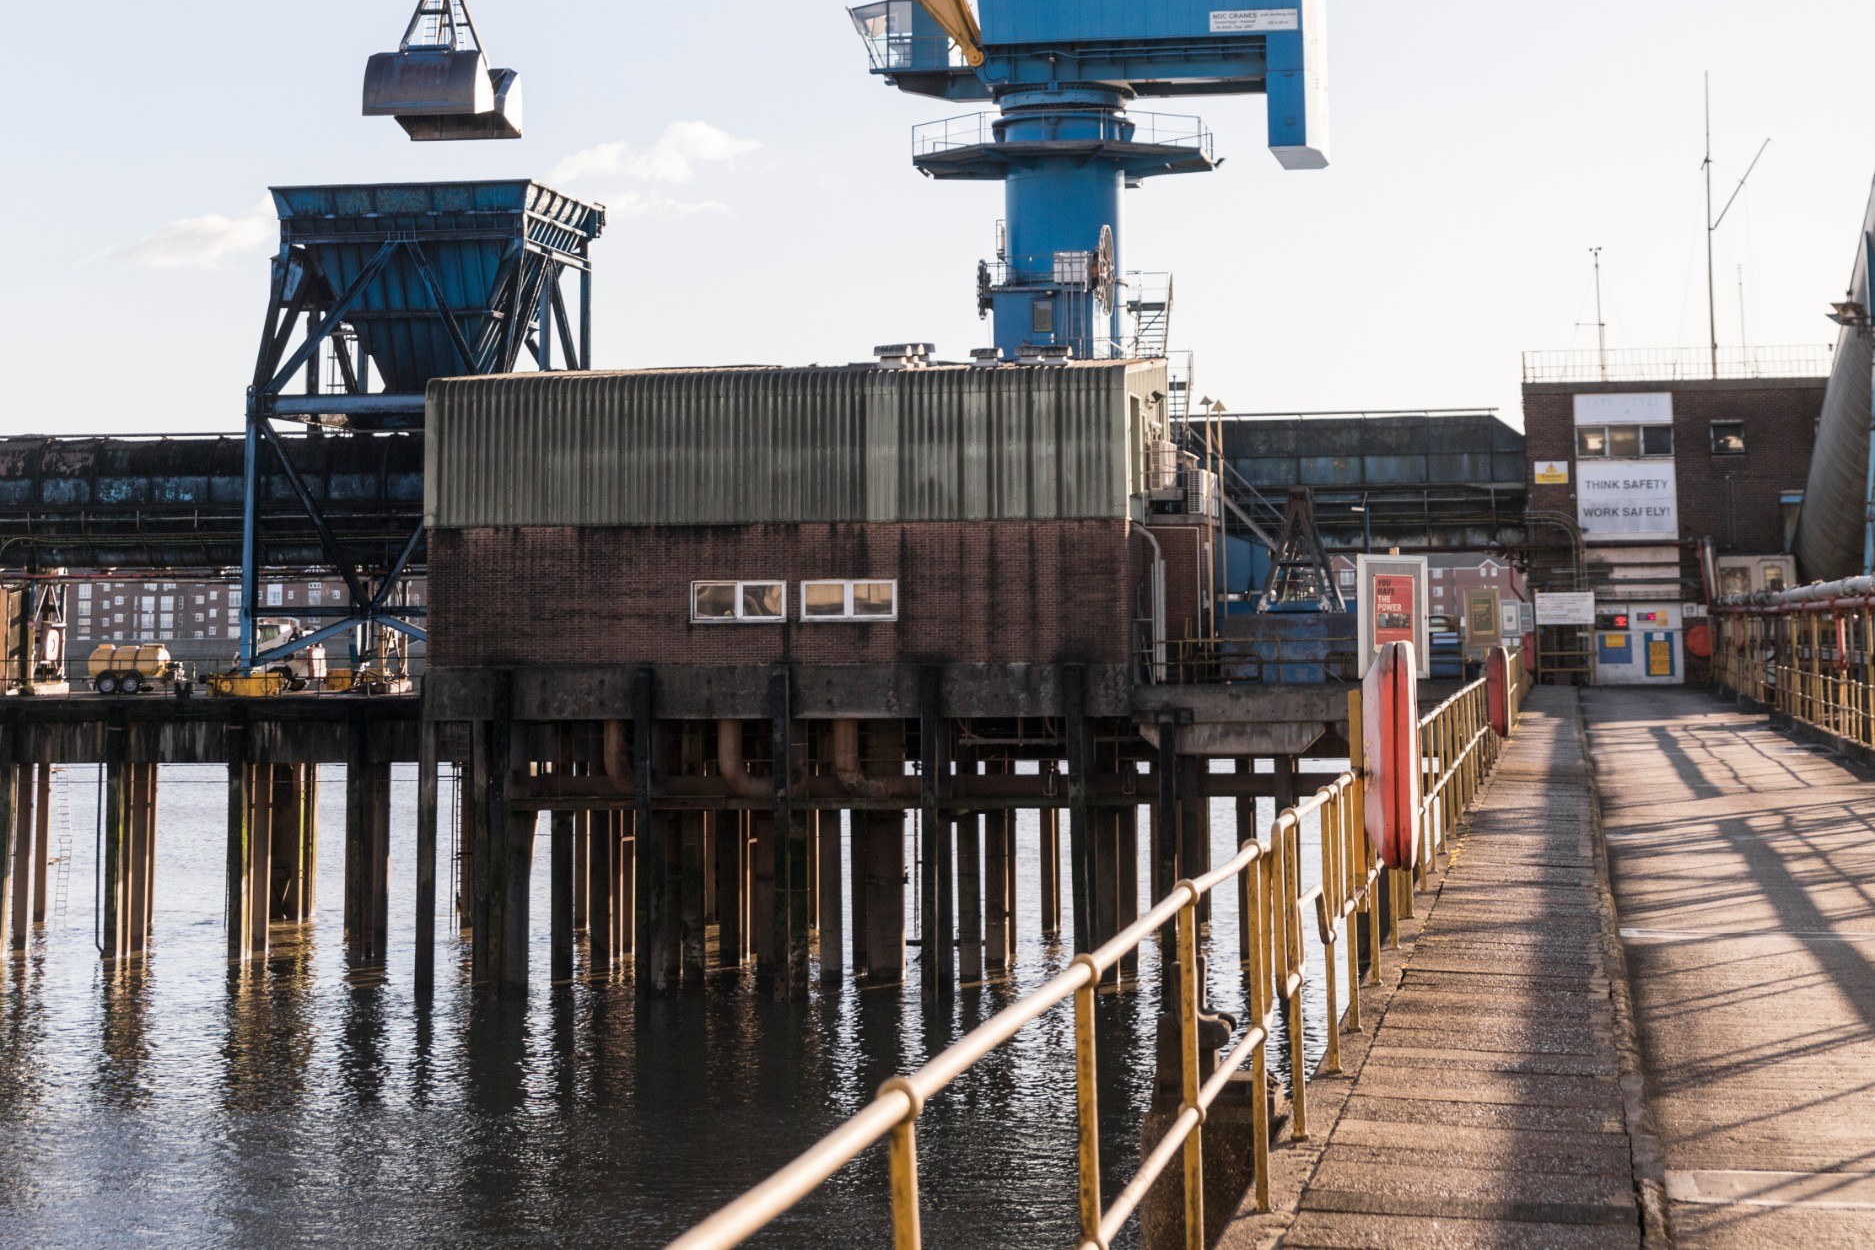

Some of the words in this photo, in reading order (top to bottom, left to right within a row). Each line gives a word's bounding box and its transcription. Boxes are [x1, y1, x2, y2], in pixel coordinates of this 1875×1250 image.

[1585, 480, 1619, 490] THINK
[1623, 479, 1668, 488] SAFETY
[1583, 508, 1619, 517] WORK
[1622, 507, 1670, 516] SAFELY!
